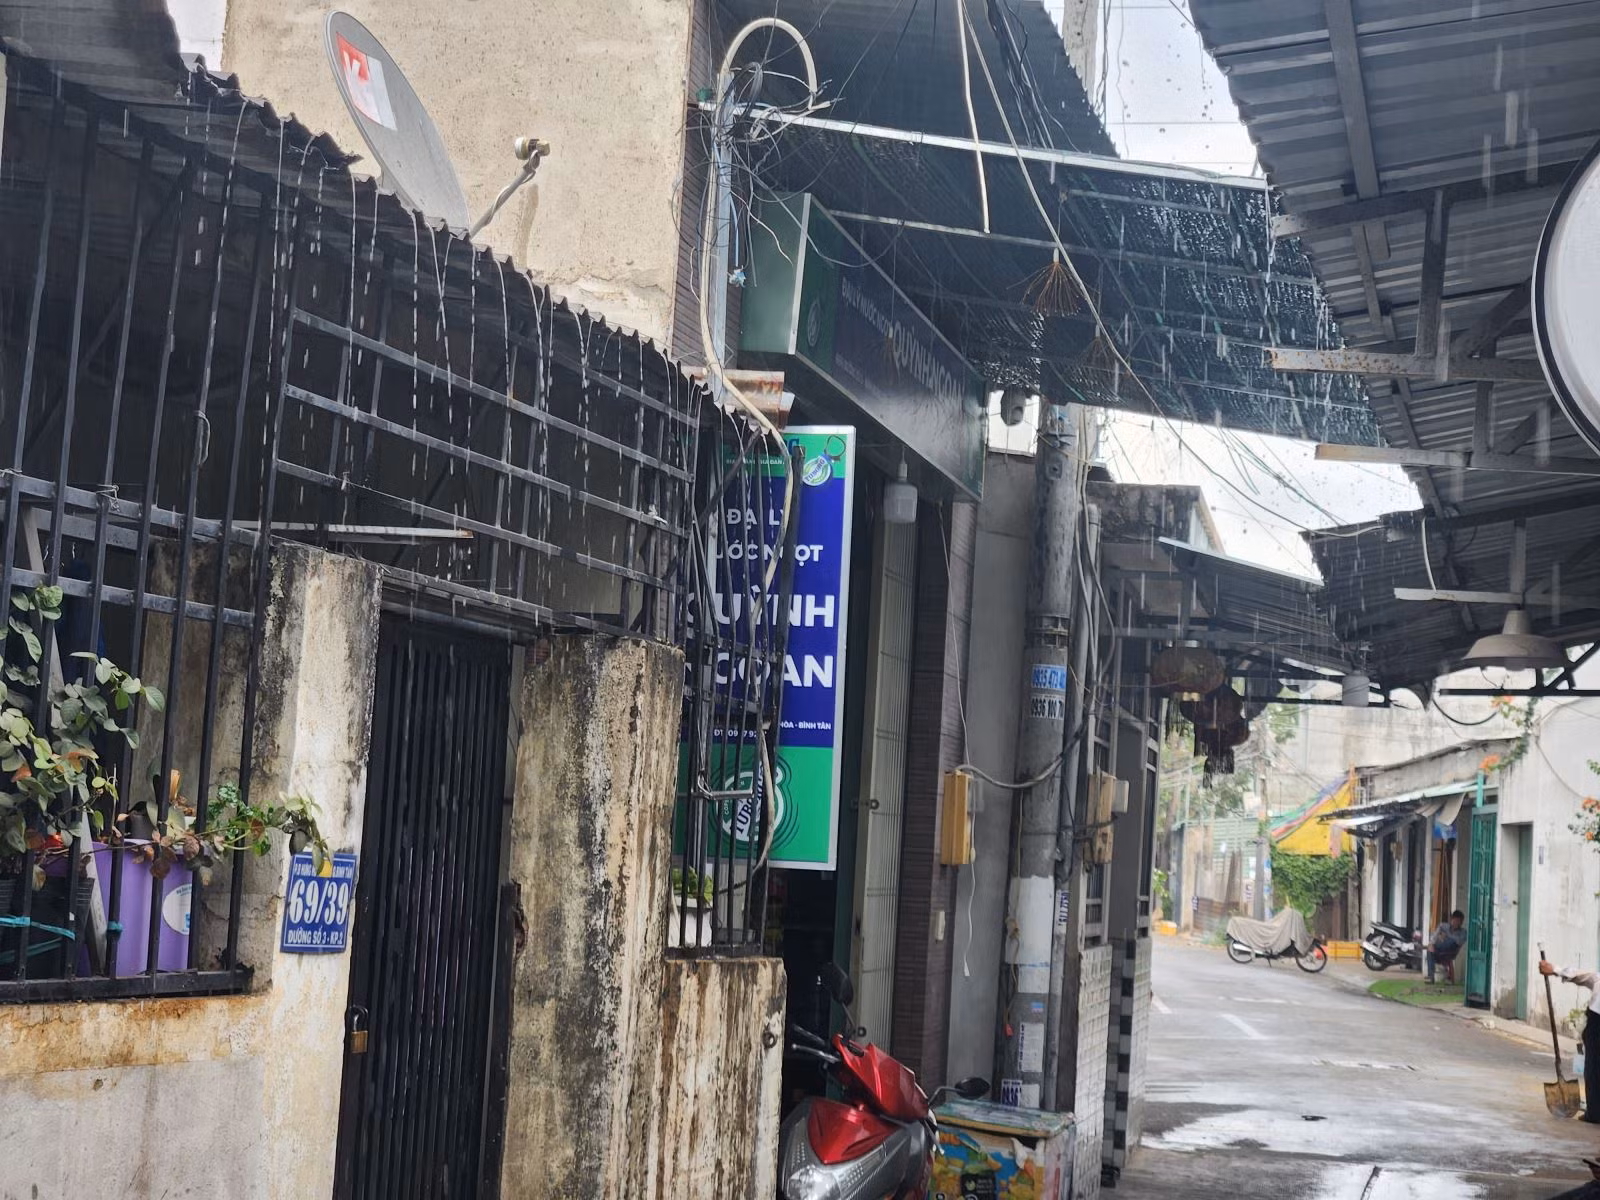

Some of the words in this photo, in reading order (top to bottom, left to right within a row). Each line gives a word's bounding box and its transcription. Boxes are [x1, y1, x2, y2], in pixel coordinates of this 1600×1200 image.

[727, 508, 758, 530] ĐẠ
[764, 544, 824, 567] NỌT
[685, 652, 834, 688] GOAN
[289, 879, 349, 925] 69/39
[288, 926, 312, 944] ĐƯỜNG
[312, 925, 322, 944] SỐ
